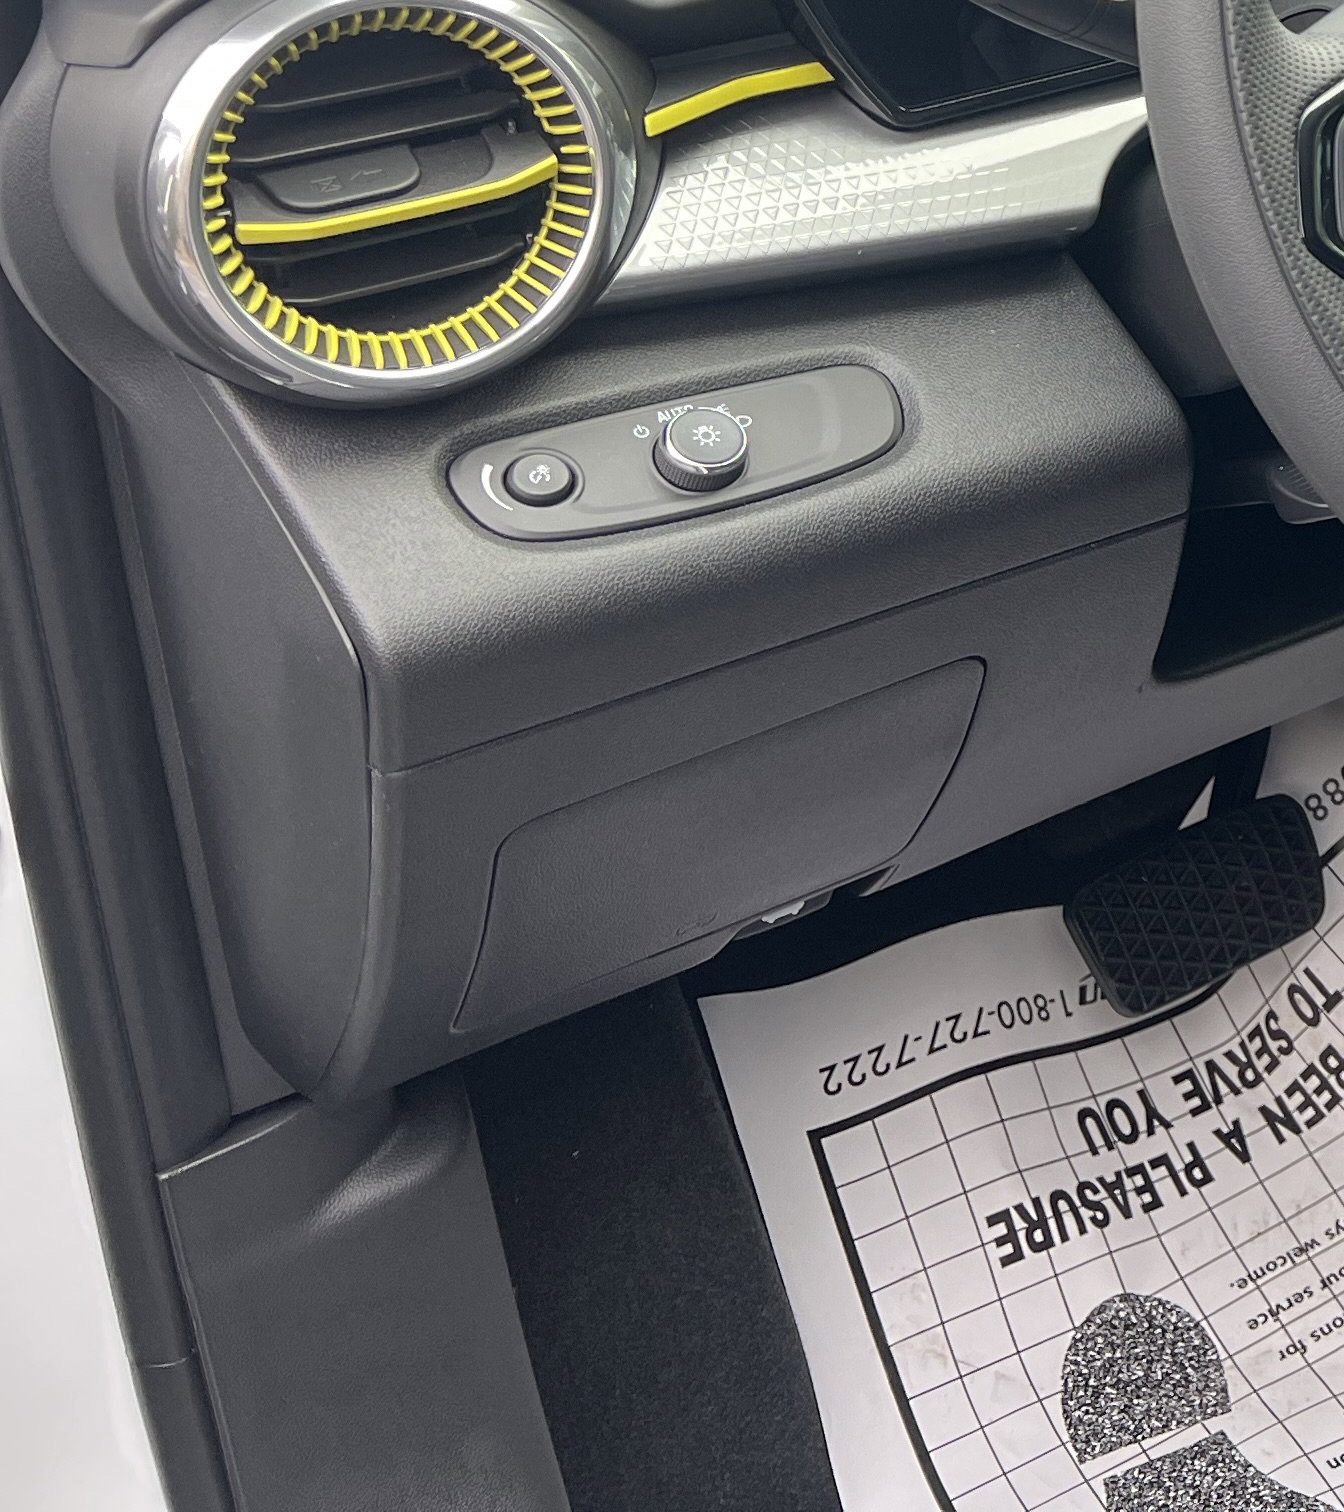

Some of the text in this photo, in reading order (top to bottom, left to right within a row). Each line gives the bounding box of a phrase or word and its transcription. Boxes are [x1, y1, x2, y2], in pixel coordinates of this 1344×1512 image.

[818, 989, 1074, 1096] 1-800-727-7222
[1076, 966, 1344, 1156] TO SERVE YOU
[1212, 1117, 1251, 1164] A
[985, 1140, 1216, 1269] PLEASURE
[1230, 1237, 1321, 1290] welcome.
[1246, 1285, 1314, 1330] service
[1279, 1339, 1308, 1362] for
